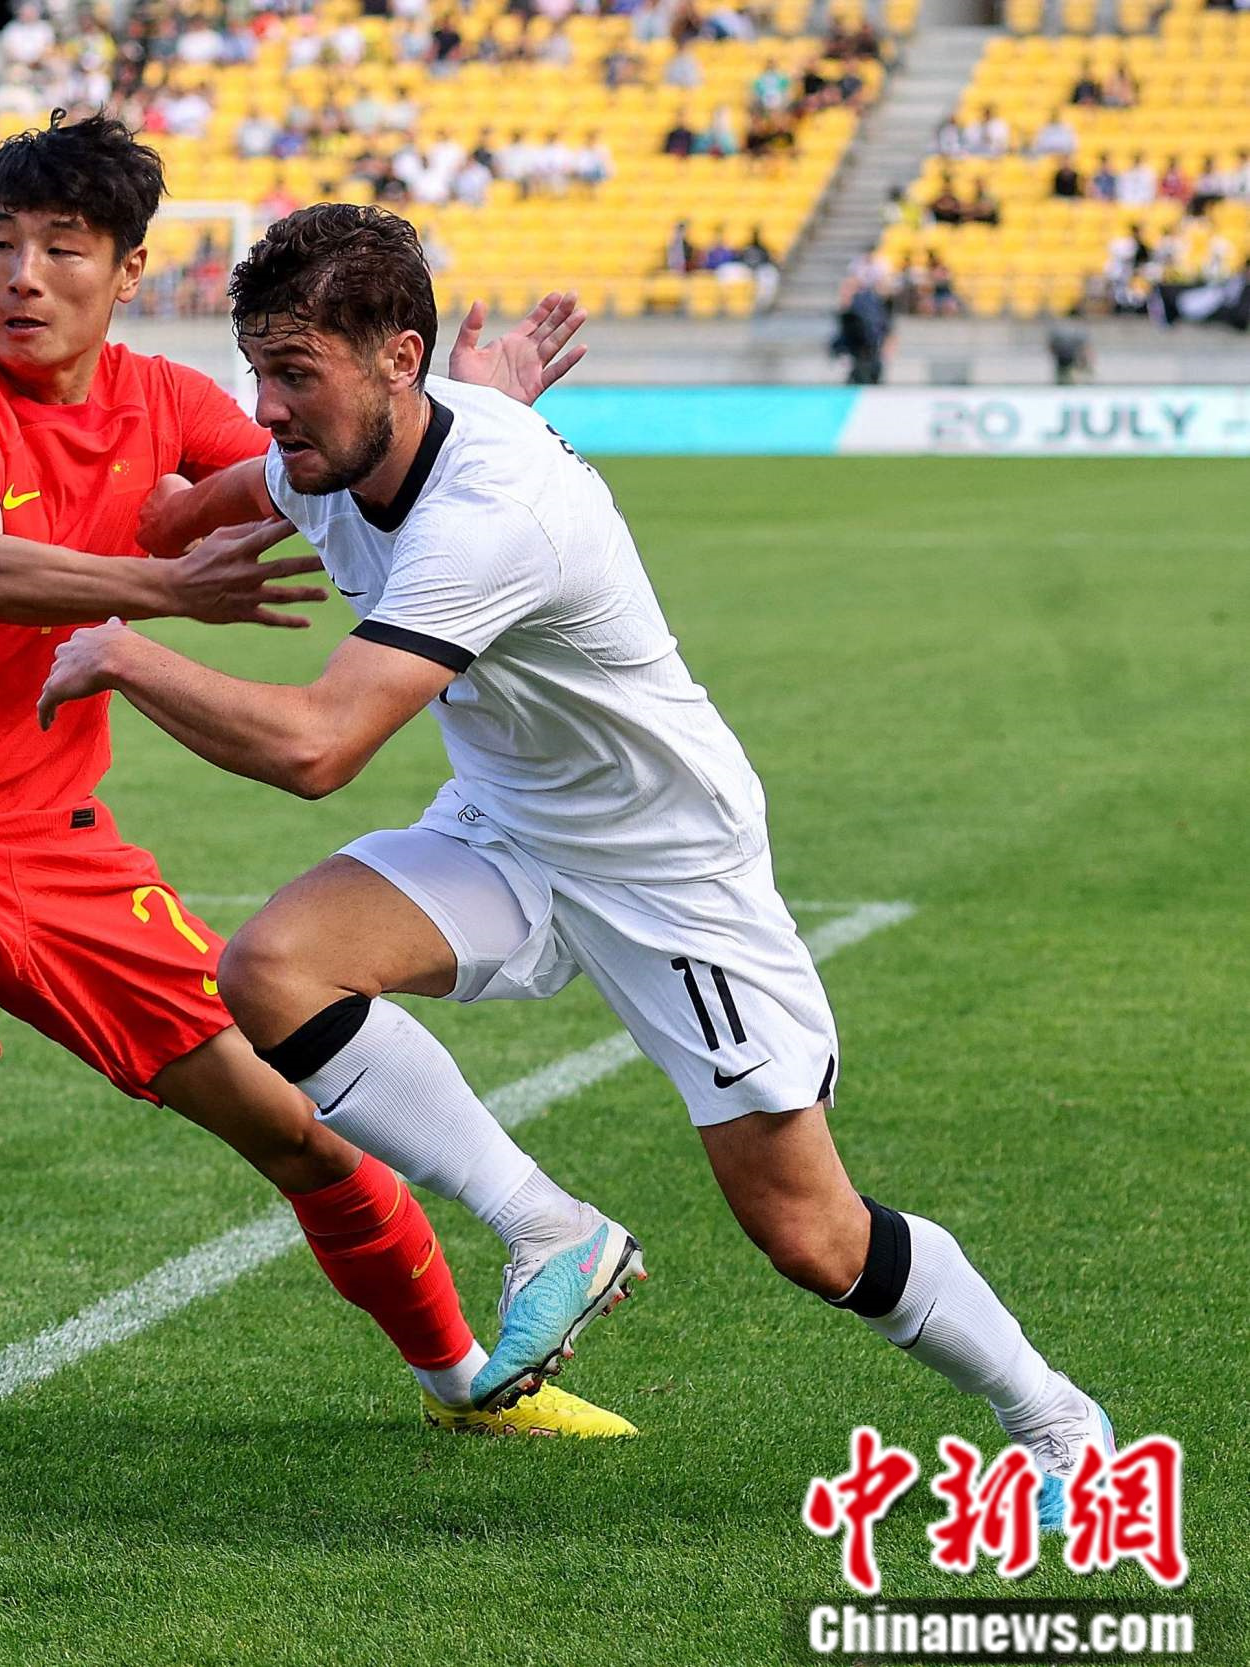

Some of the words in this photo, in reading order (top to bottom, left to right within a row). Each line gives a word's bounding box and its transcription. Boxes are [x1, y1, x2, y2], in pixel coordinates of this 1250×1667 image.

[930, 400, 1021, 438] 20
[1042, 400, 1199, 439] JULY
[670, 956, 748, 1052] 11
